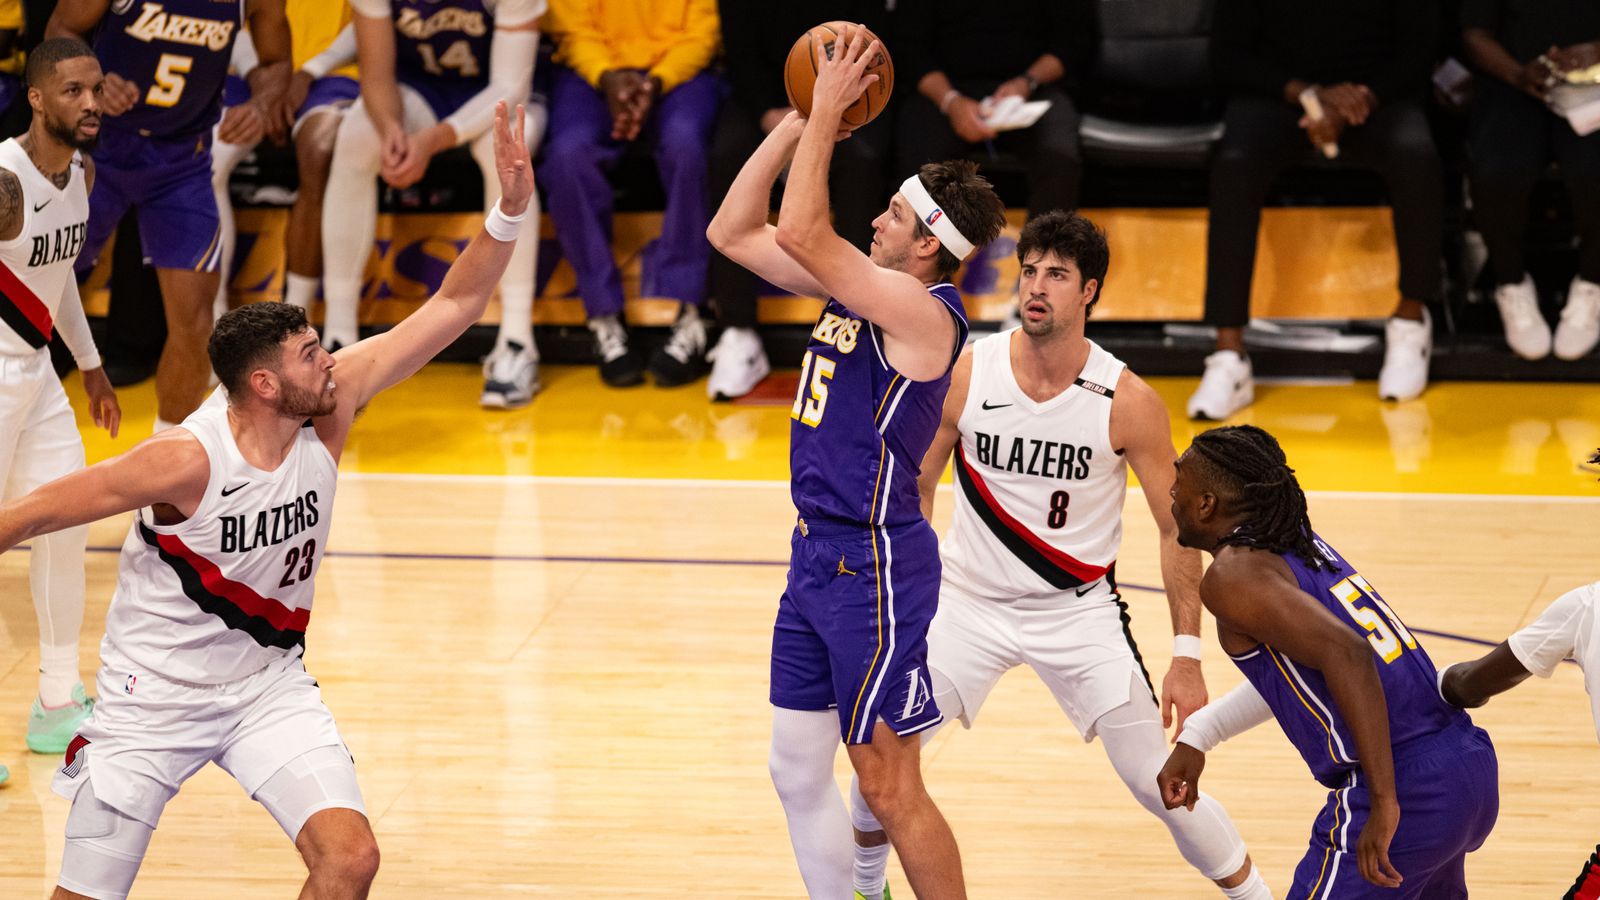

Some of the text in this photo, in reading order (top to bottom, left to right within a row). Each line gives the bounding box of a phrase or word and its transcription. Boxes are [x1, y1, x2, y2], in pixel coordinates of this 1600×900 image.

[124, 2, 234, 51] LAKERS
[396, 7, 486, 39] LAKERS
[145, 53, 194, 108] 5
[417, 40, 479, 77] 14
[28, 221, 87, 267] BLAZER
[790, 350, 837, 428] 15
[974, 431, 1093, 480] BLAZERS
[218, 490, 319, 553] BLAZERS
[1047, 489, 1071, 529] 8
[278, 538, 317, 589] 23
